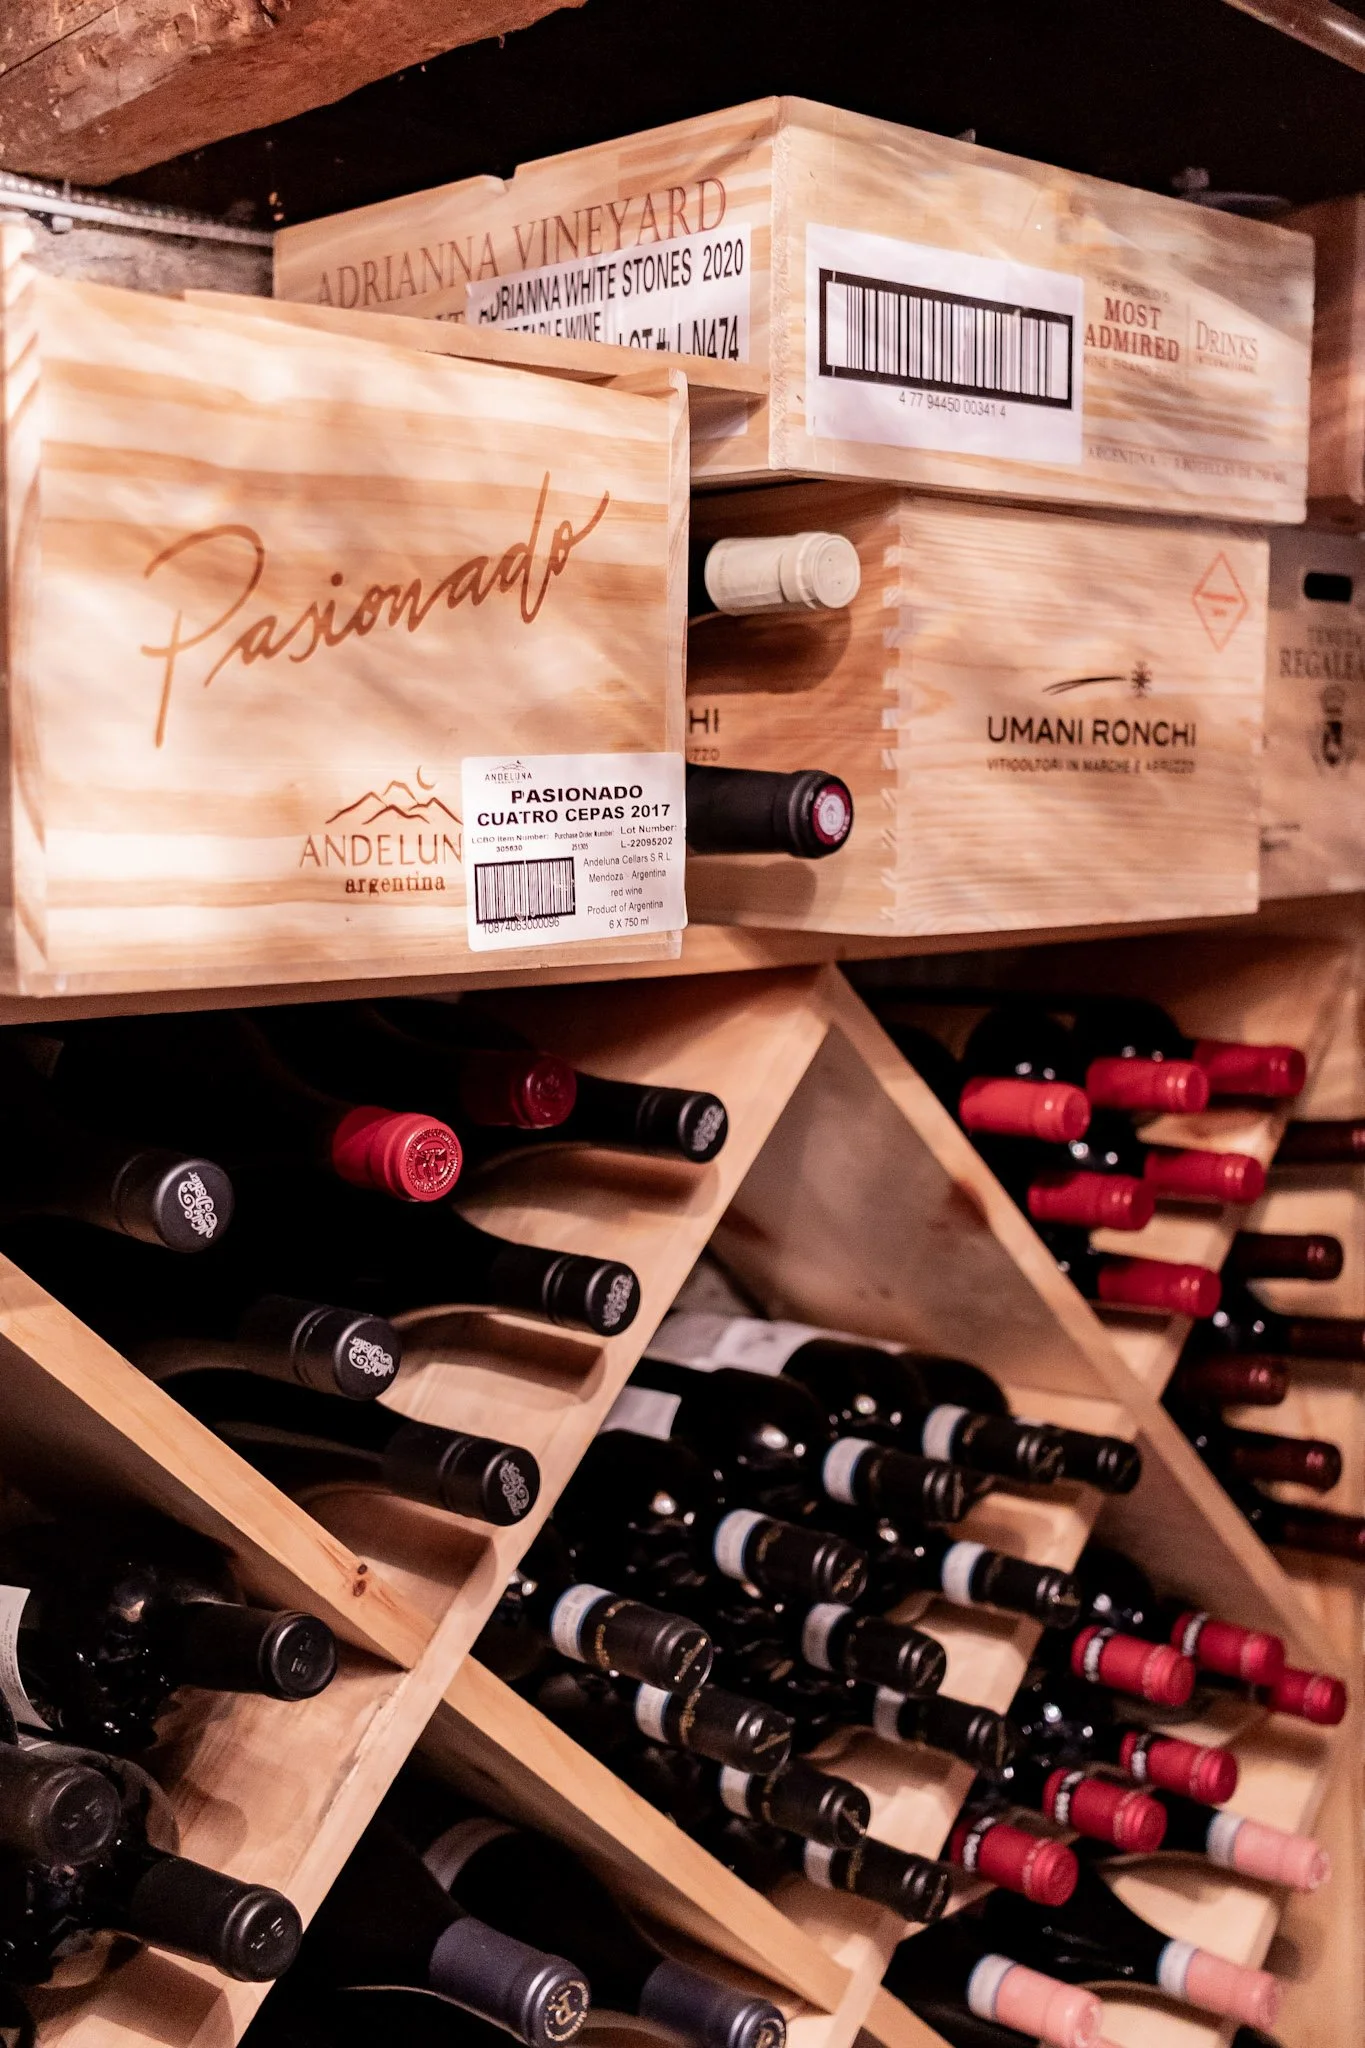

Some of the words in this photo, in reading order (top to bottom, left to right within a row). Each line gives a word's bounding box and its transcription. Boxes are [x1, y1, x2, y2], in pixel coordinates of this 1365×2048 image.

[317, 231, 500, 309] ADRIANNA
[512, 176, 727, 269] VINEYARD
[564, 263, 617, 307] WHITE
[622, 247, 692, 297] STONES
[702, 238, 744, 282] 2020
[1103, 297, 1162, 331] MOST
[1083, 323, 1181, 363] ADMIRED
[899, 391, 906, 406] 4
[910, 391, 923, 407] 77
[927, 393, 961, 413] 94450
[963, 399, 997, 417] 00341
[1000, 405, 1007, 418] 4
[140, 470, 610, 748] Pasionado
[987, 715, 1083, 746] UMANI
[1092, 718, 1197, 748] RONCHI
[484, 772, 533, 781] ANDELUNA
[511, 785, 643, 804] PASIONADO
[477, 810, 558, 827] CUATRO
[565, 806, 625, 822] CEPAS
[631, 803, 671, 818] 2017
[554, 831, 578, 841] Purchase
[578, 831, 593, 839] Order
[620, 826, 636, 835] Lot
[638, 823, 677, 833] Number:
[497, 835, 515, 843] Item
[620, 836, 673, 849] L-22095202
[299, 832, 463, 868] ANDELUN
[583, 857, 620, 868] Andeluna
[621, 854, 648, 865] Cellars
[345, 870, 446, 897] argentina
[588, 872, 624, 883] Mendoza
[631, 868, 666, 881] Argentina
[610, 888, 623, 897] red
[625, 885, 643, 896] wine
[587, 903, 617, 915] Product
[619, 902, 627, 912] of
[628, 899, 664, 913] Argentina
[608, 919, 614, 929] 6
[616, 919, 622, 929] X
[624, 917, 639, 927] 750
[640, 916, 650, 926] ml
